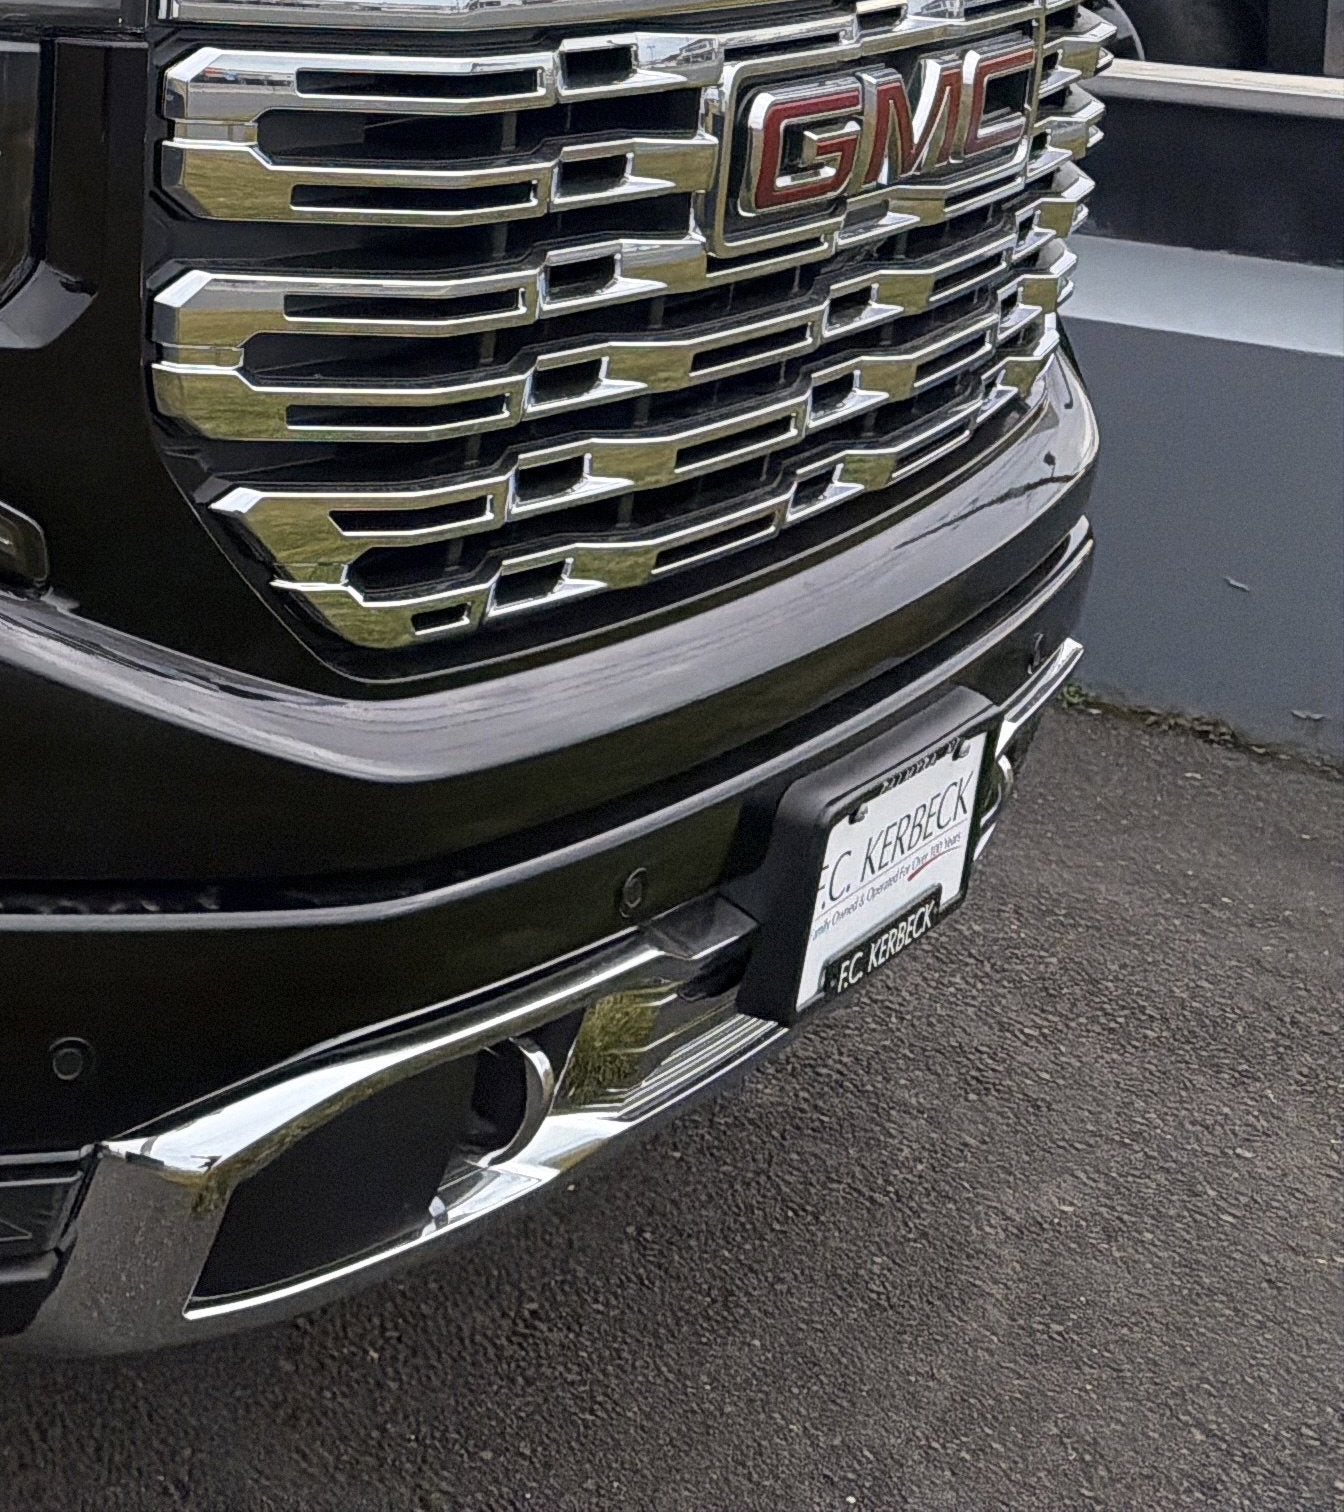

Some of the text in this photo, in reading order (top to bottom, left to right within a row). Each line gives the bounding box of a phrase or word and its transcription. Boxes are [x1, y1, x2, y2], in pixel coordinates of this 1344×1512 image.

[742, 40, 1036, 217] GMC
[860, 770, 974, 883] KERBECK
[868, 899, 937, 973] KERBECK
